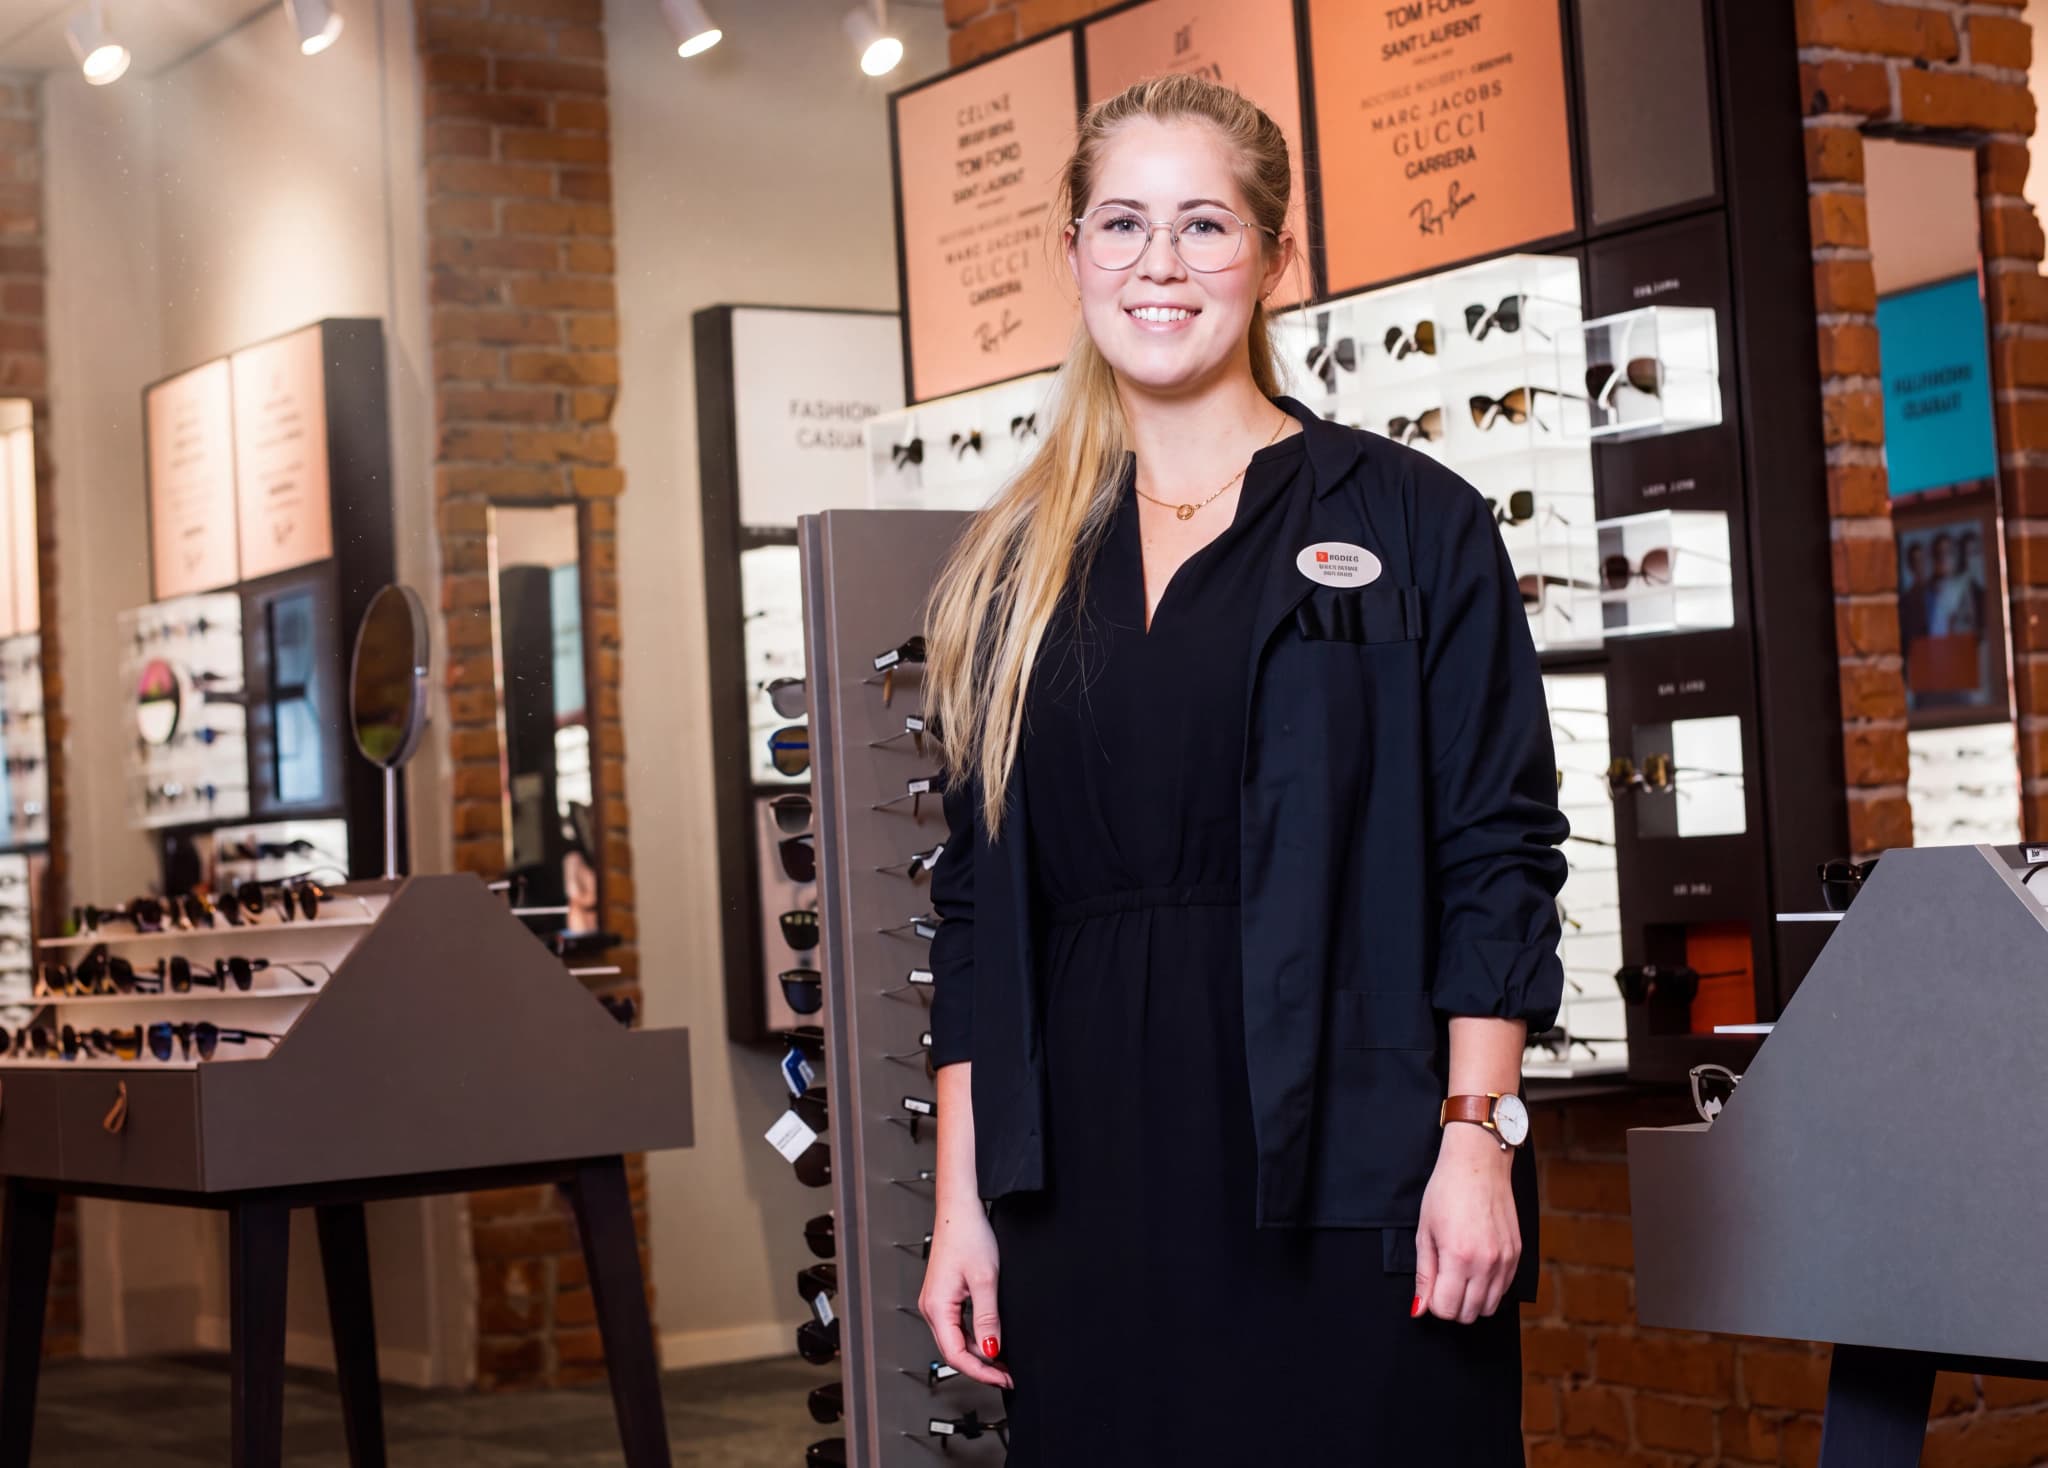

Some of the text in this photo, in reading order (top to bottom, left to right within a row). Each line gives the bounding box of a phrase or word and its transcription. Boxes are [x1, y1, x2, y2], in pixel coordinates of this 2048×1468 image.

[1385, 0, 1475, 30] TOM FO
[1372, 104, 1420, 131] MARC
[1430, 79, 1503, 117] JACOBS
[1393, 109, 1486, 157] GUCCI
[1405, 144, 1477, 179] CARRERA
